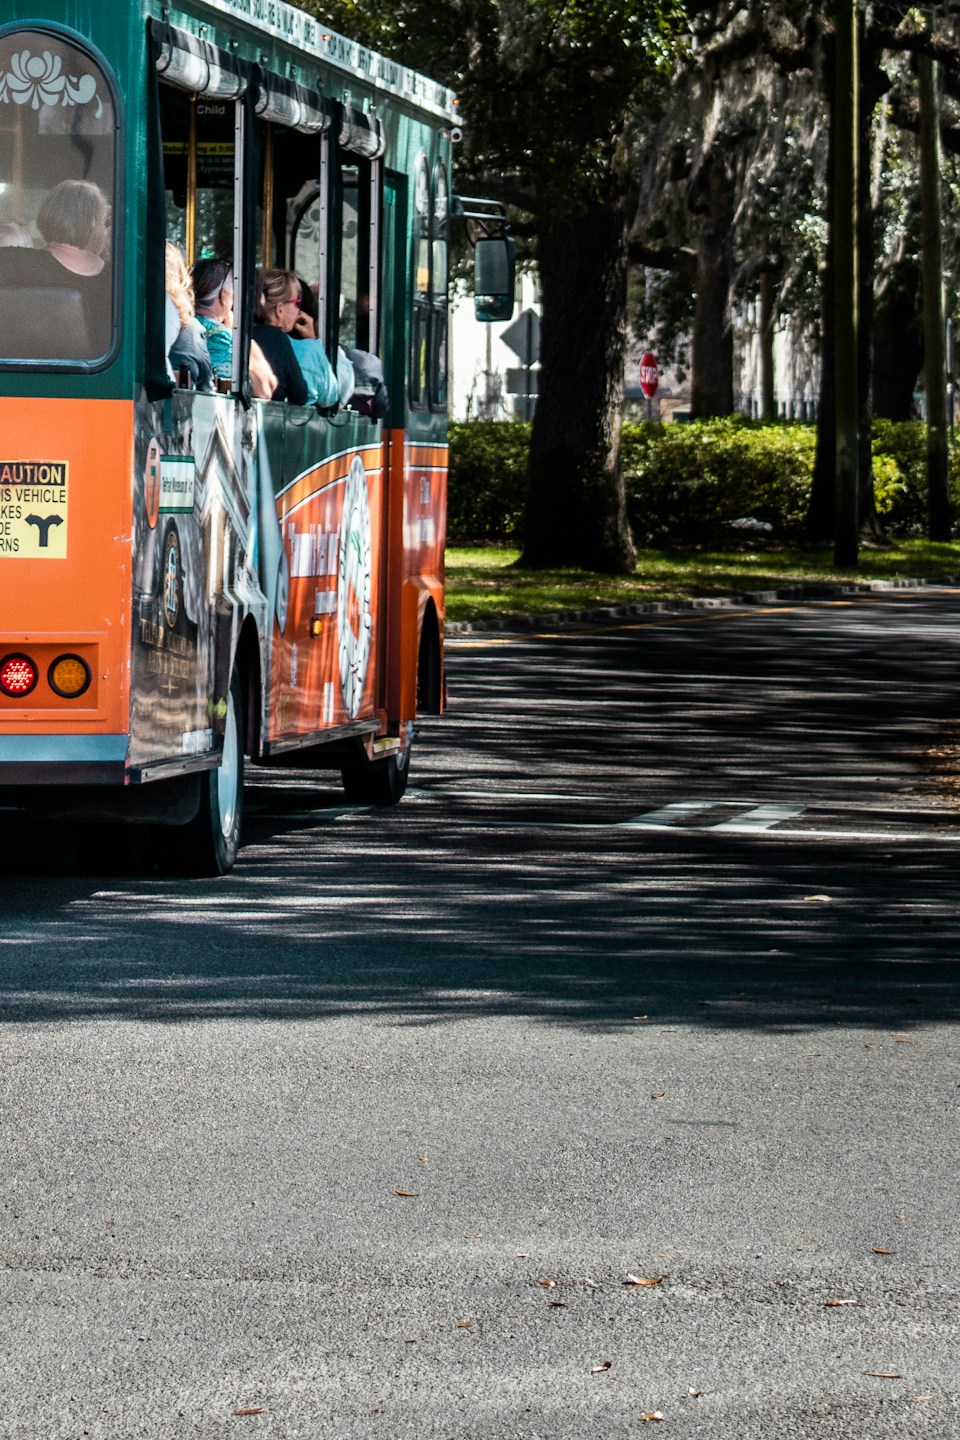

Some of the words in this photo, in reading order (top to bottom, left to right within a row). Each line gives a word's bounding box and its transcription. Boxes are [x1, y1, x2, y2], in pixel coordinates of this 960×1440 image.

[197, 104, 226, 115] Child
[640, 365, 658, 384] STOP
[15, 488, 66, 503] VEHICLE
